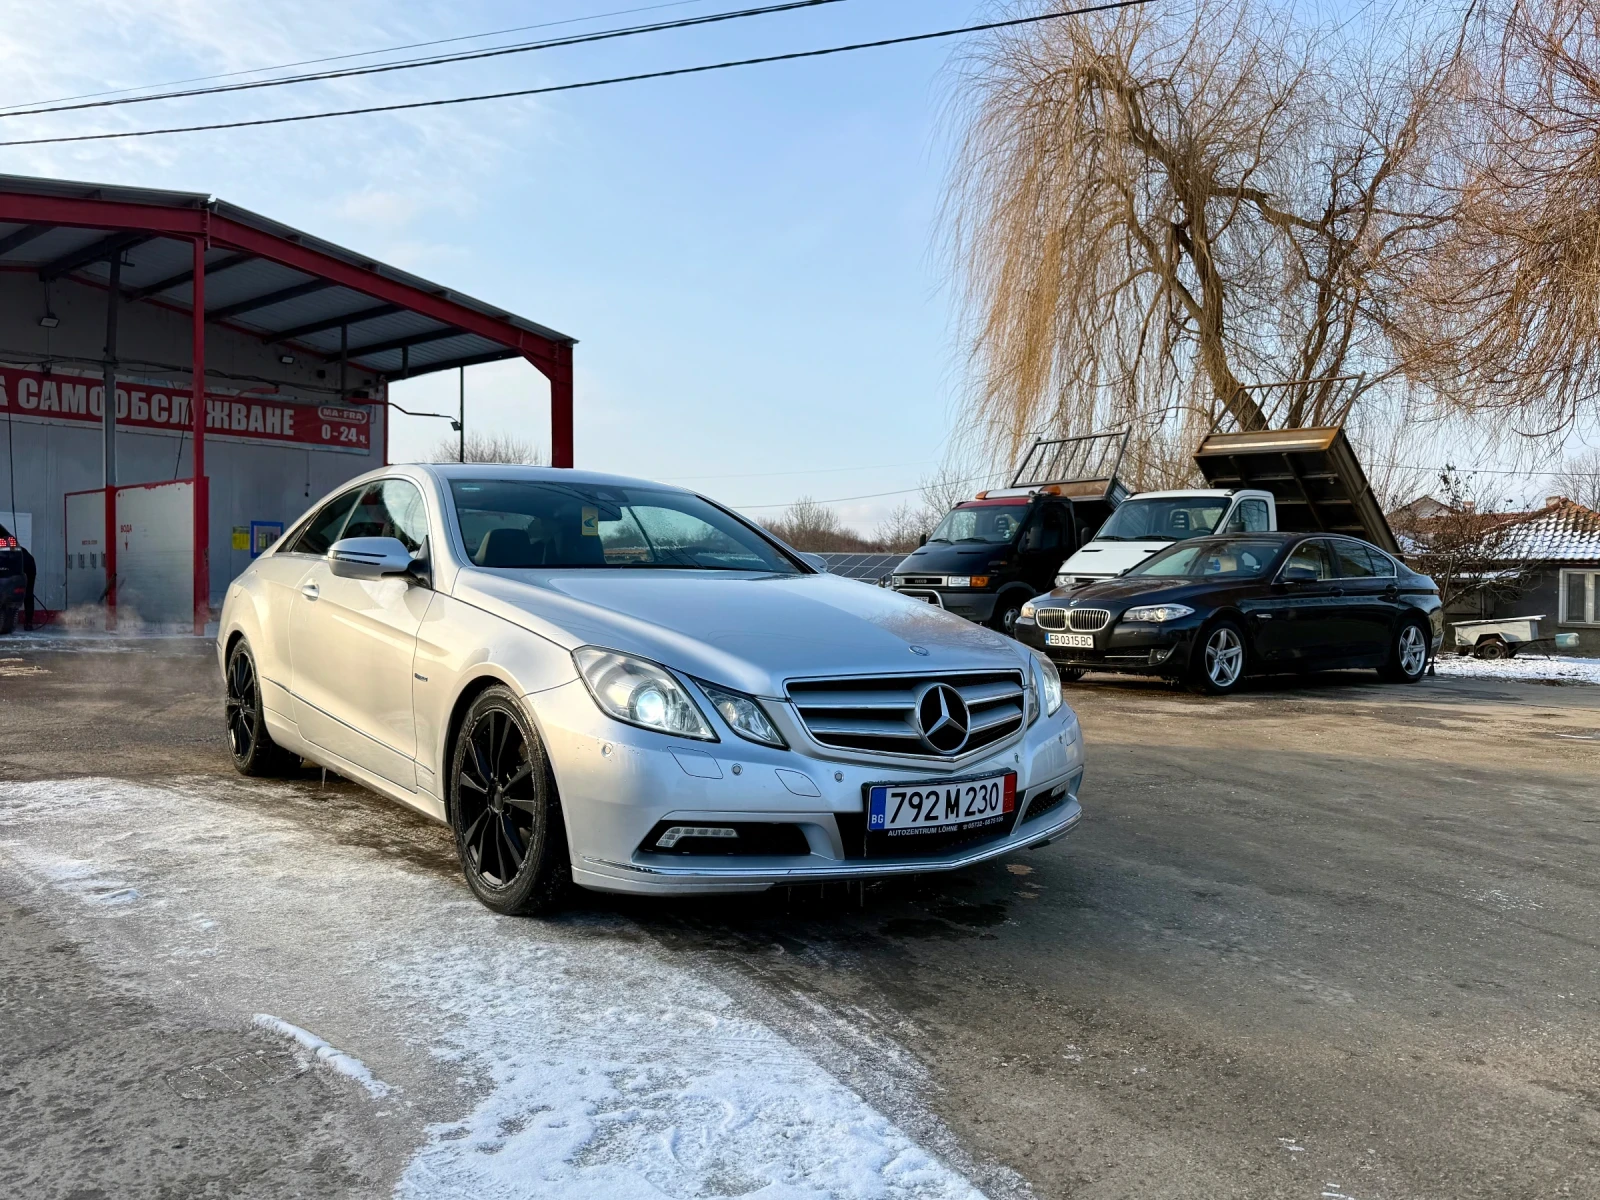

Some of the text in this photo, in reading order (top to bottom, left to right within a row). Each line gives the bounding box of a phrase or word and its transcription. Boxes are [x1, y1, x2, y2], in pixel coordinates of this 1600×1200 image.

[18, 377, 295, 436] САМООБСЛЖВАНЕ
[120, 524, 133, 533] ВОДА
[871, 814, 884, 824] BG
[888, 822, 937, 837] AUTOZENTRUM
